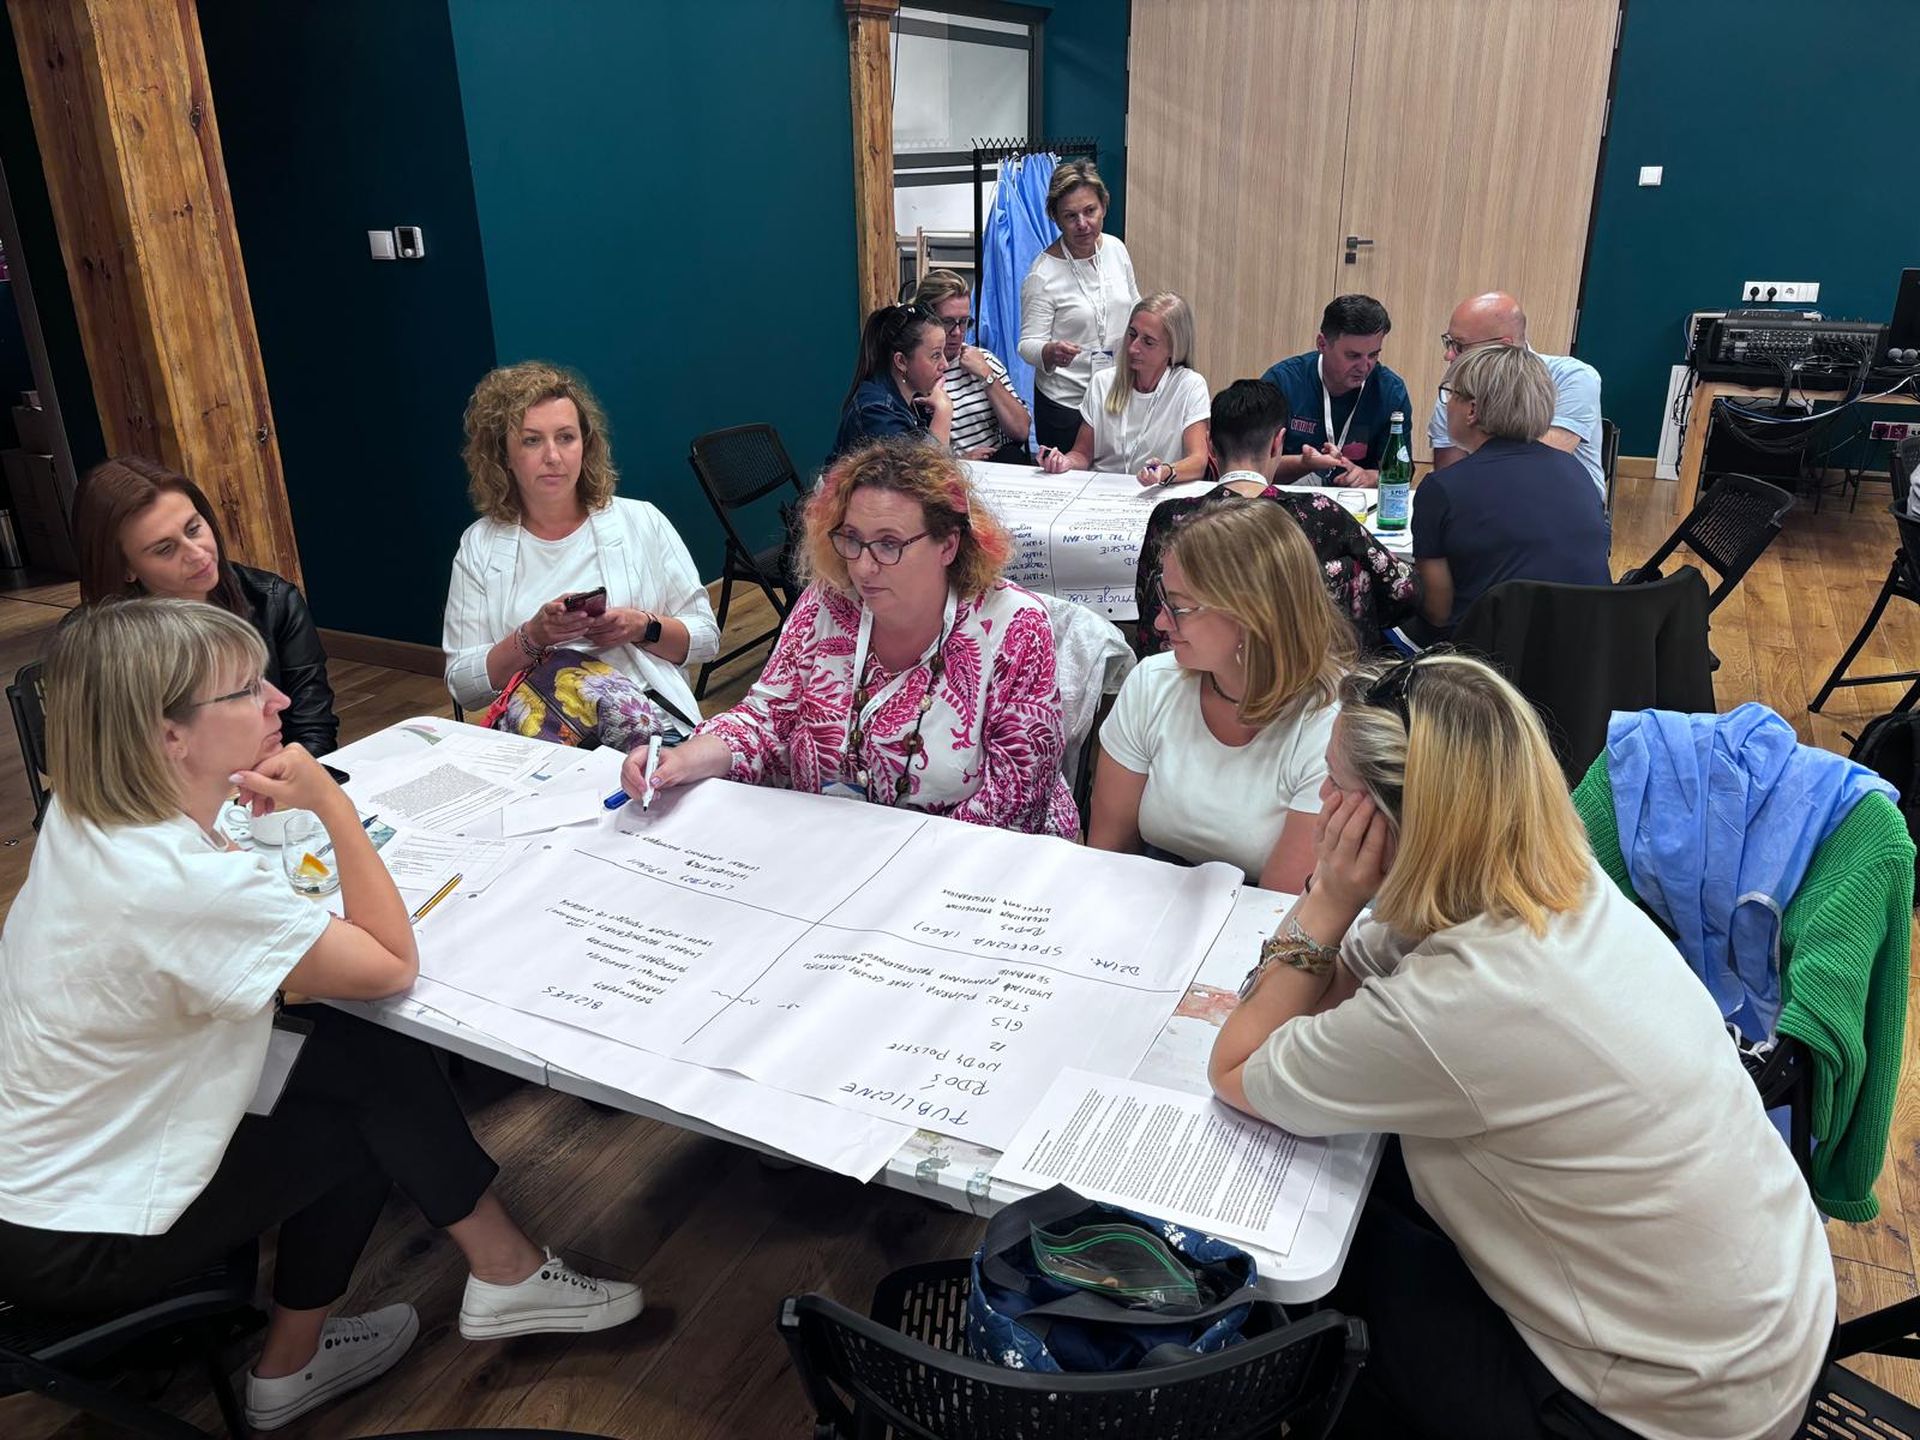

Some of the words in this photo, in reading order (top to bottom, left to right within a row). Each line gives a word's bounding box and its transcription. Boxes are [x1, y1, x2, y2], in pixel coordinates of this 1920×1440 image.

[541, 984, 604, 1010] BIZNES
[990, 1016, 1024, 1032] GIS
[884, 1042, 950, 1060] POLSKIE
[918, 1073, 990, 1097] RDOŚ
[838, 1082, 969, 1126] PUBLICZNE
